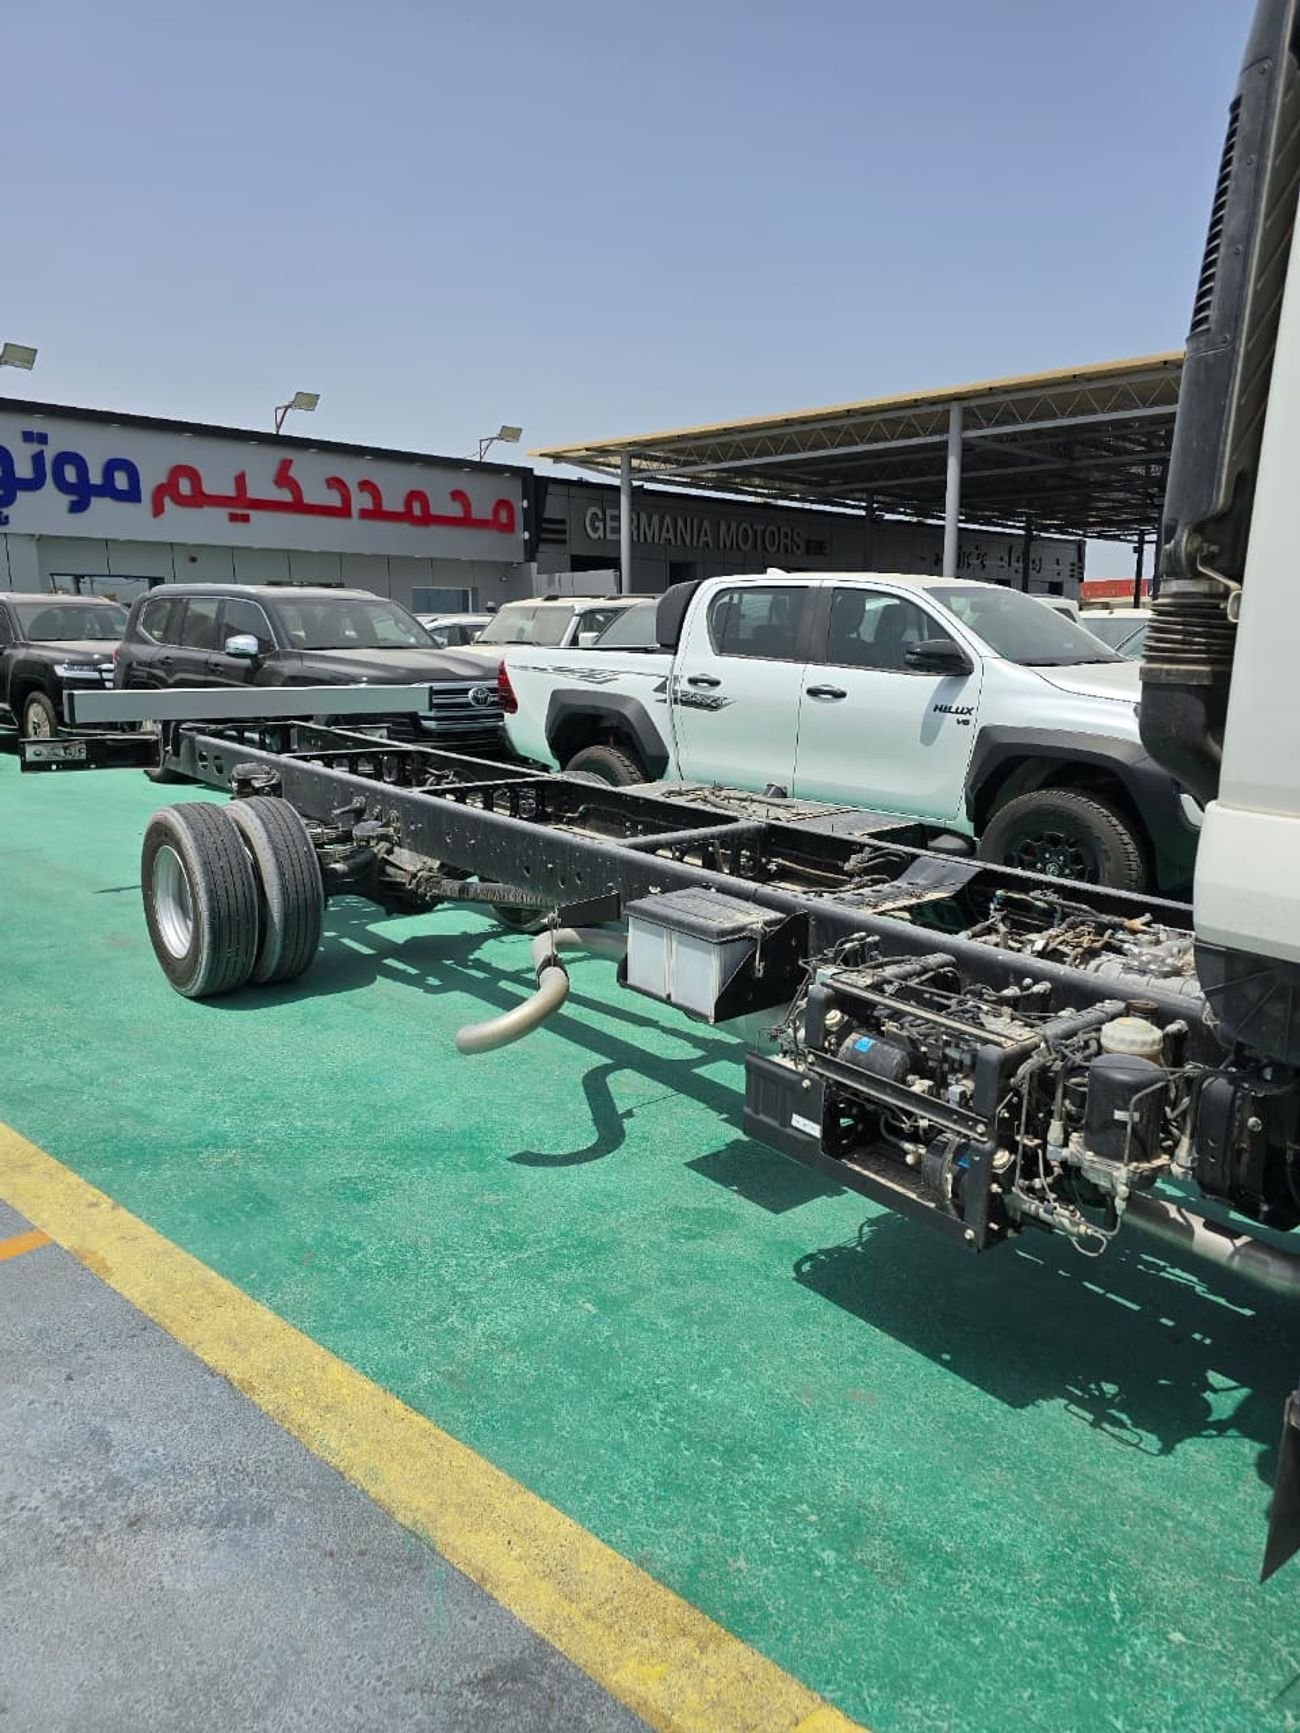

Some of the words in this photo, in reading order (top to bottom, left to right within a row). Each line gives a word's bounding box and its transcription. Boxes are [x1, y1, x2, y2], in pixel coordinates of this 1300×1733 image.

[152, 458, 352, 523] حكيم
[358, 479, 516, 533] محمد
[719, 520, 806, 555] MOTORS
[933, 704, 975, 716] HILUX
